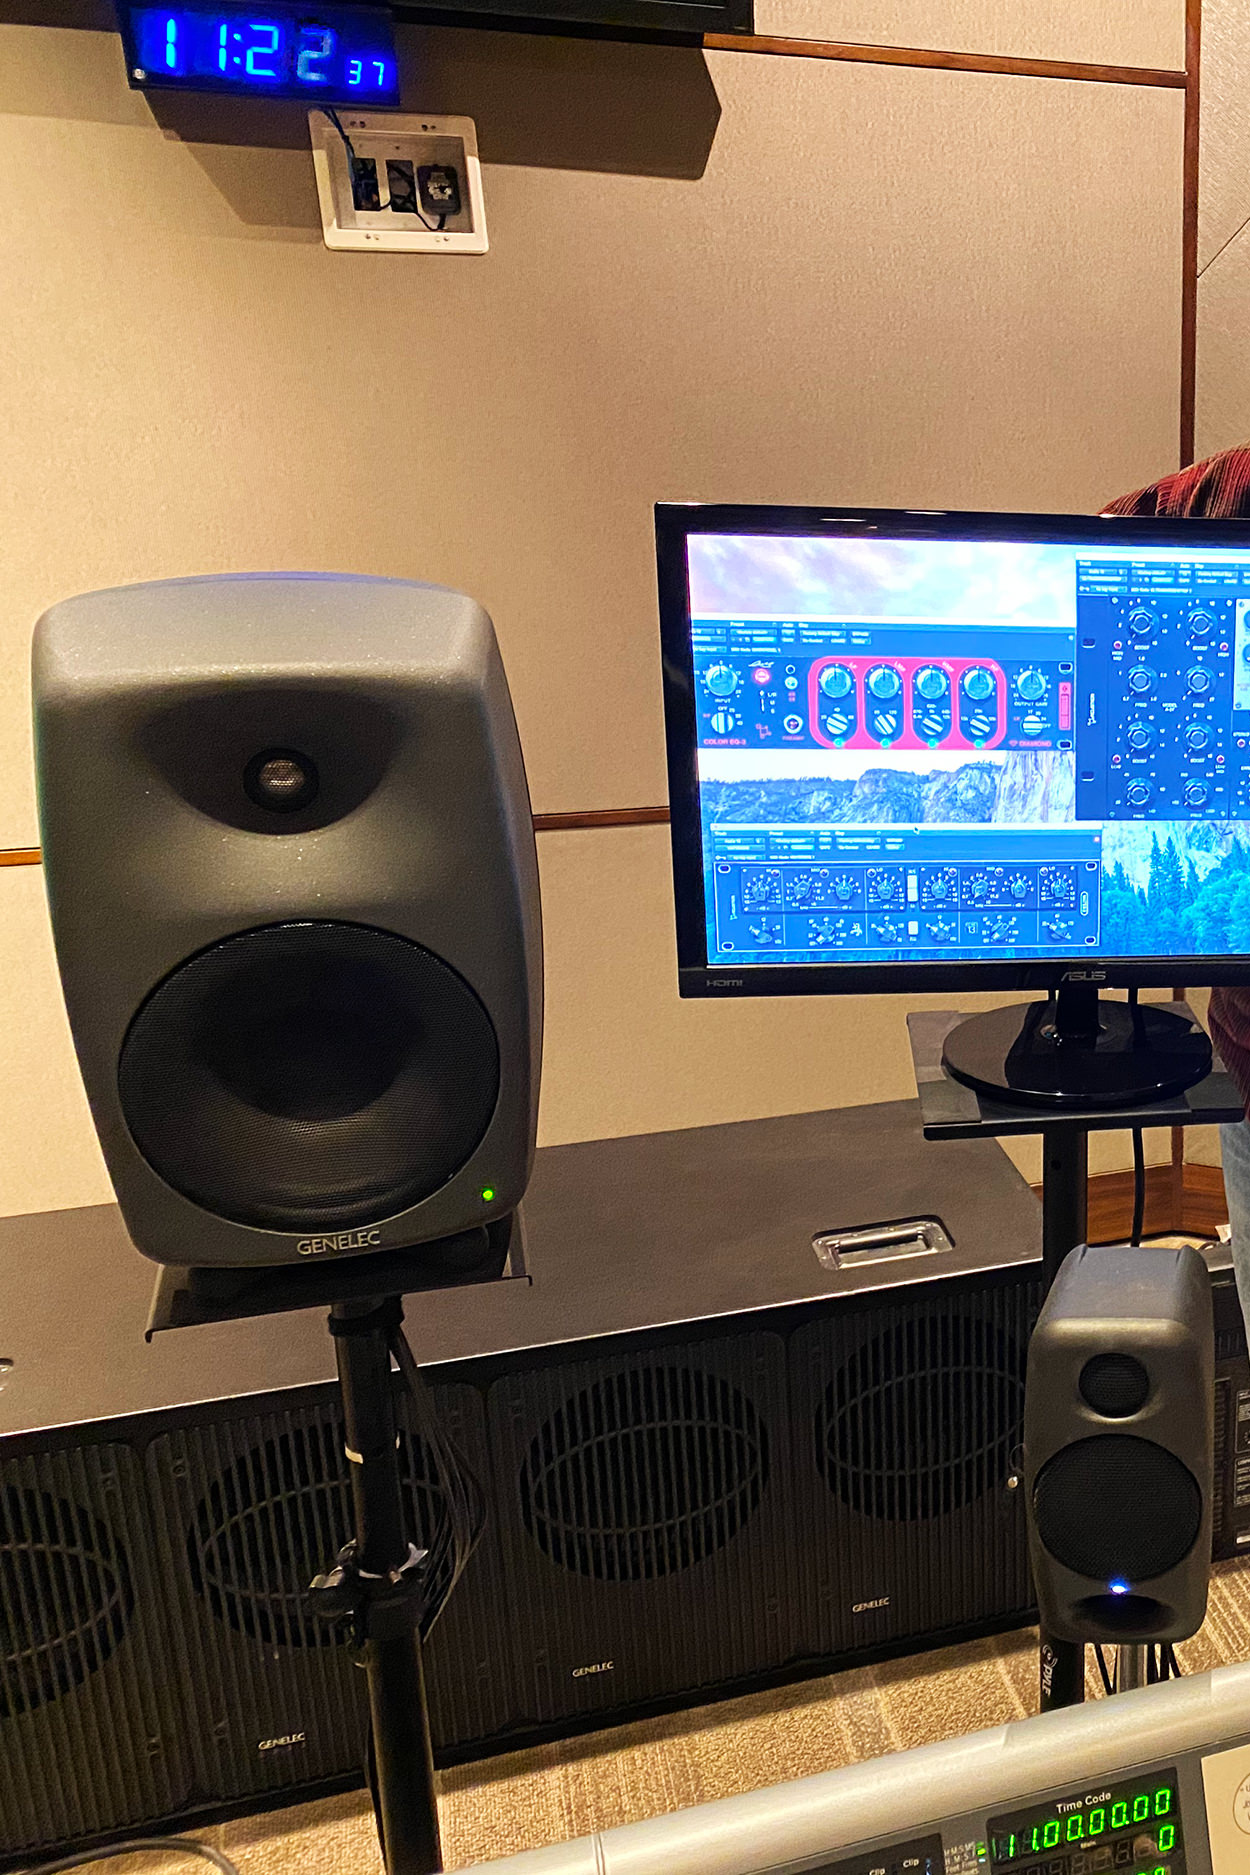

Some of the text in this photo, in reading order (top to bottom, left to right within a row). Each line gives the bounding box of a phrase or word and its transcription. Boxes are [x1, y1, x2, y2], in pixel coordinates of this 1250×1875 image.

[348, 59, 386, 86] 37
[703, 738, 729, 746] COLOR
[1060, 970, 1107, 982] ASUS
[296, 1230, 380, 1255] GENELEC
[852, 1597, 890, 1613] GENELEC
[572, 1661, 614, 1678] GENELEC
[1042, 1663, 1053, 1698] PYLE
[258, 1732, 305, 1751] GENELEC
[1056, 1792, 1112, 1814] Time Code
[902, 1858, 920, 1868] Clip
